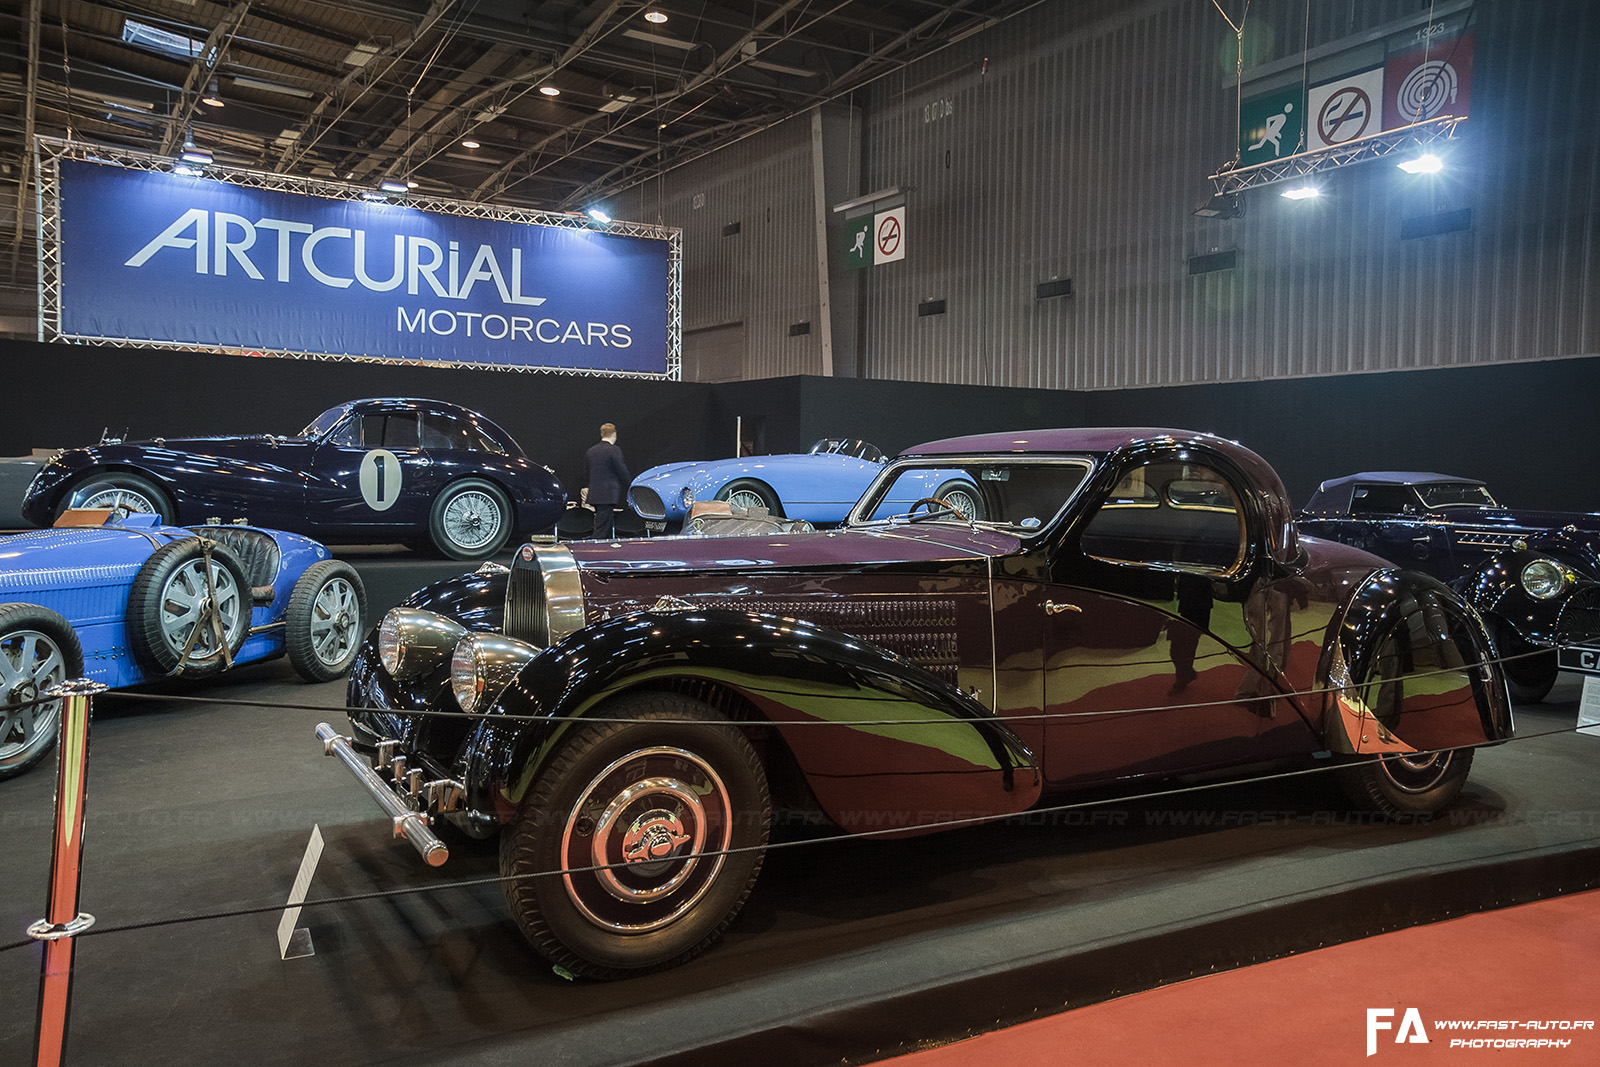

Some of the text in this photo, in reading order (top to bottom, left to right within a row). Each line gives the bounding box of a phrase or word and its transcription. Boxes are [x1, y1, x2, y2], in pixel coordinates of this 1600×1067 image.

[1415, 22, 1445, 41] 1323
[396, 306, 633, 349] MOTORCARS
[373, 455, 385, 502] 1
